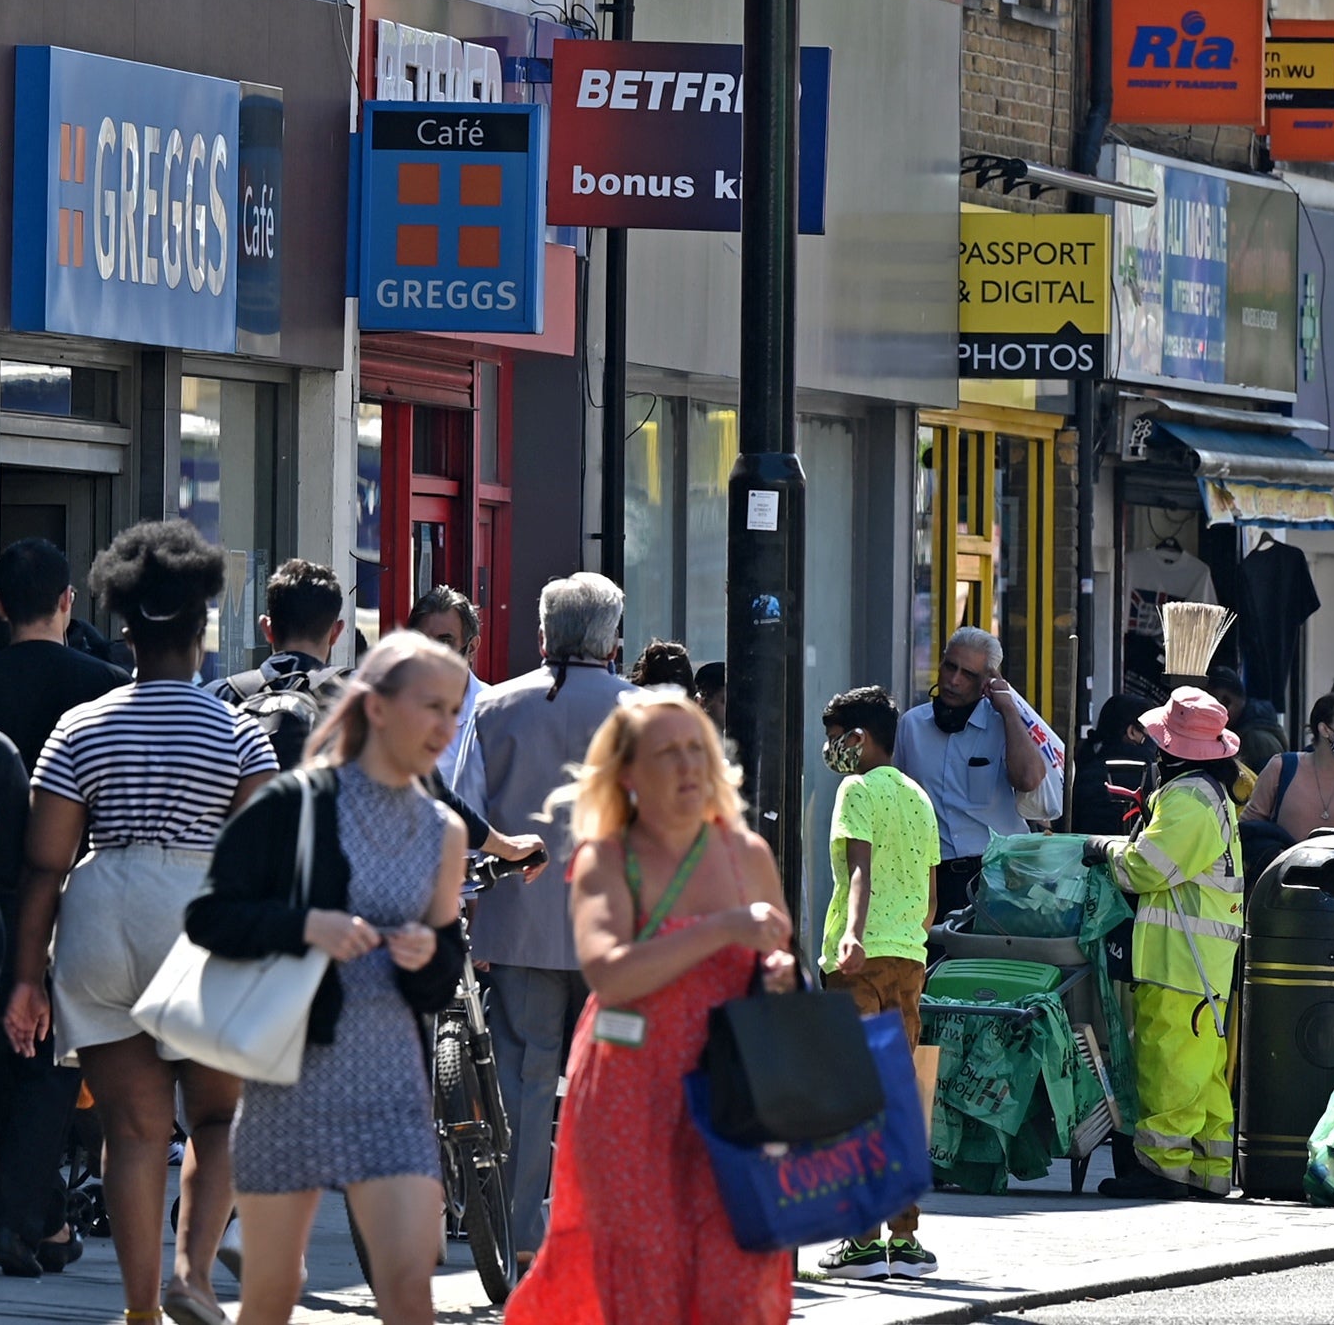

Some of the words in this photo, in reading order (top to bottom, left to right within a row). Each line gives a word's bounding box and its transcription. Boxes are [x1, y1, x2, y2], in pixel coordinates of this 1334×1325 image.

[1128, 11, 1235, 70] Ria
[576, 69, 803, 115] BETFR
[416, 118, 485, 147] Café
[572, 166, 695, 199] bonus
[94, 115, 227, 297] GREGGS
[243, 183, 275, 260] Café
[377, 279, 517, 312] GREGGS
[981, 280, 1095, 304] DIGITAL
